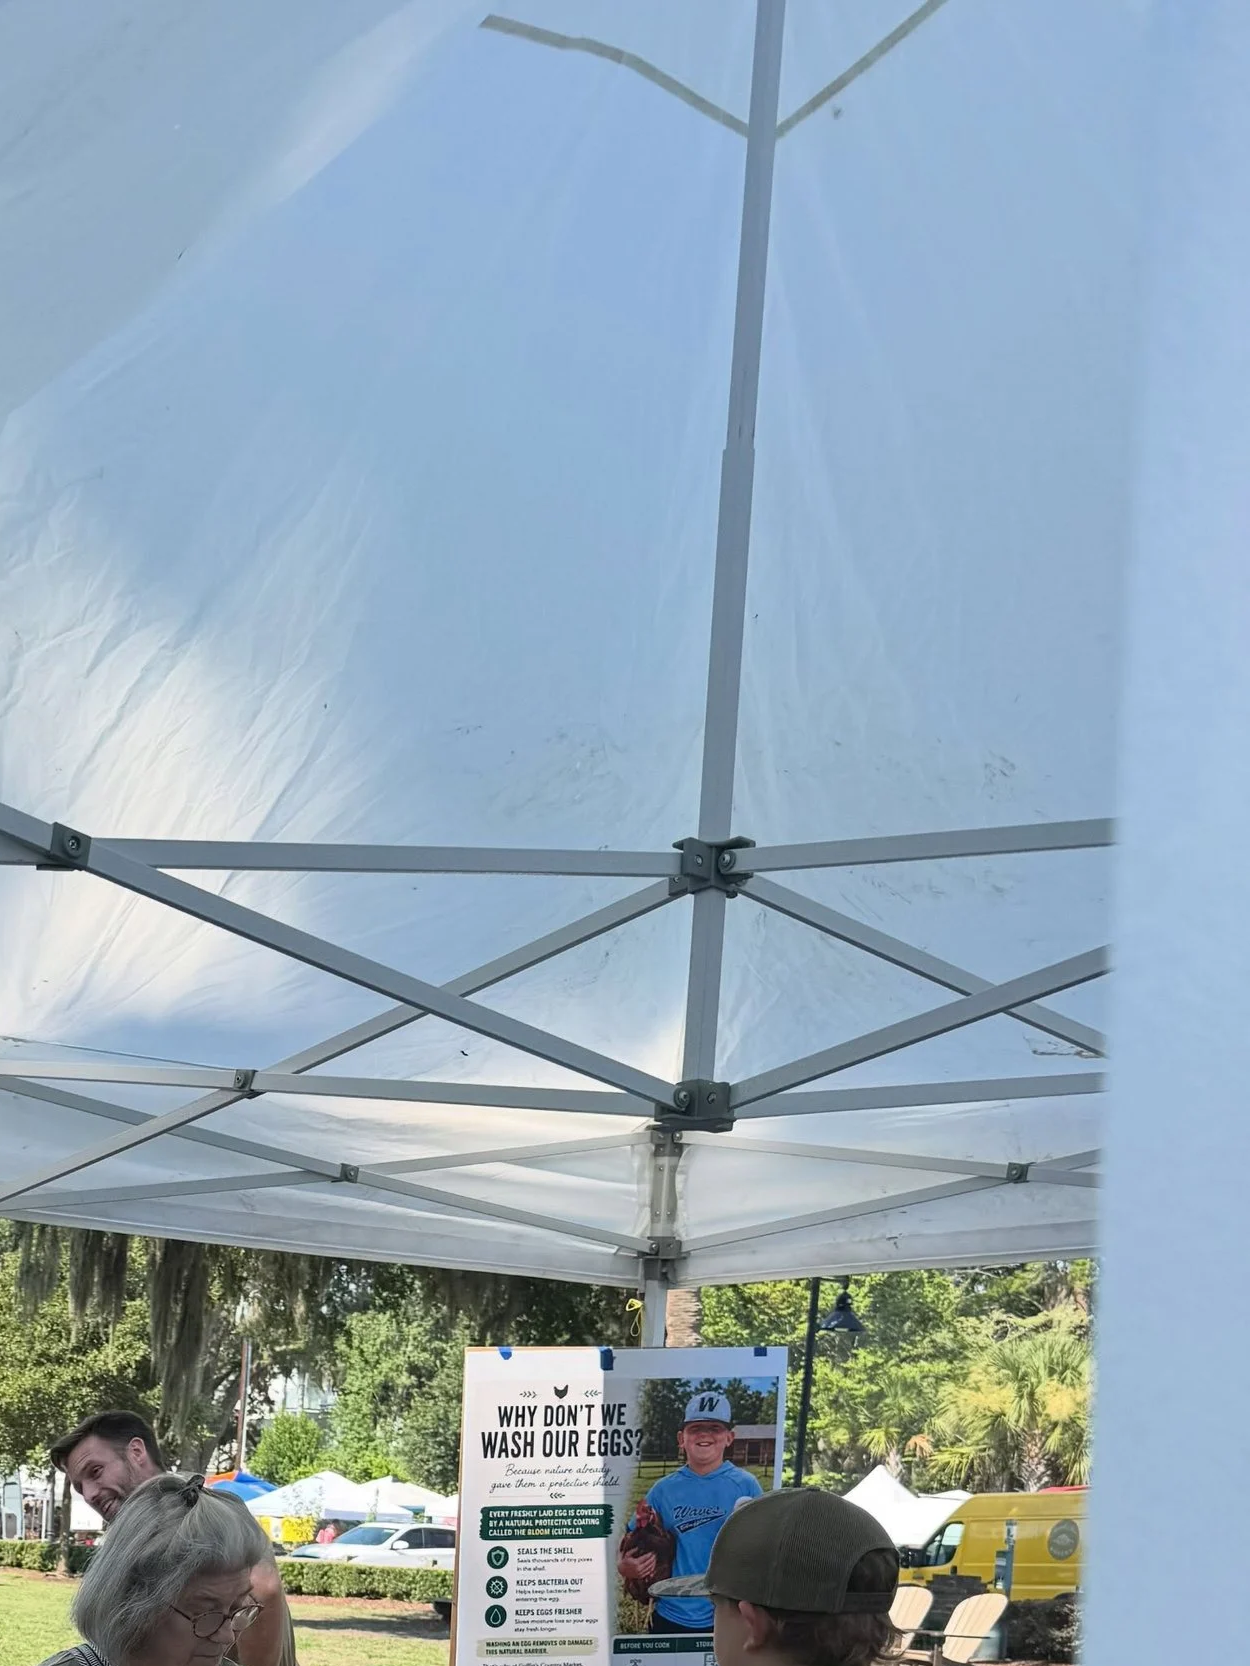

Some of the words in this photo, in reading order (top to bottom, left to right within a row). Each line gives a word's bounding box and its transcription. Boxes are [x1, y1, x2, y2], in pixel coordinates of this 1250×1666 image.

[698, 1397, 719, 1412] W
[498, 1406, 538, 1427] WHY
[544, 1404, 595, 1426] DON'T
[601, 1404, 627, 1426] WE
[481, 1431, 535, 1458] WASH
[542, 1430, 579, 1457] OUR
[586, 1429, 644, 1457] EGGS?
[505, 1463, 541, 1476] Because
[545, 1465, 573, 1474] nature
[576, 1463, 612, 1478] already
[489, 1481, 511, 1493] gave
[515, 1478, 536, 1488] them
[547, 1479, 590, 1491] protective
[576, 1508, 605, 1516] COVERED
[505, 1519, 533, 1527] NATURAL
[534, 1518, 572, 1526] PROTECTIVE
[537, 1578, 569, 1586] BACTERIA
